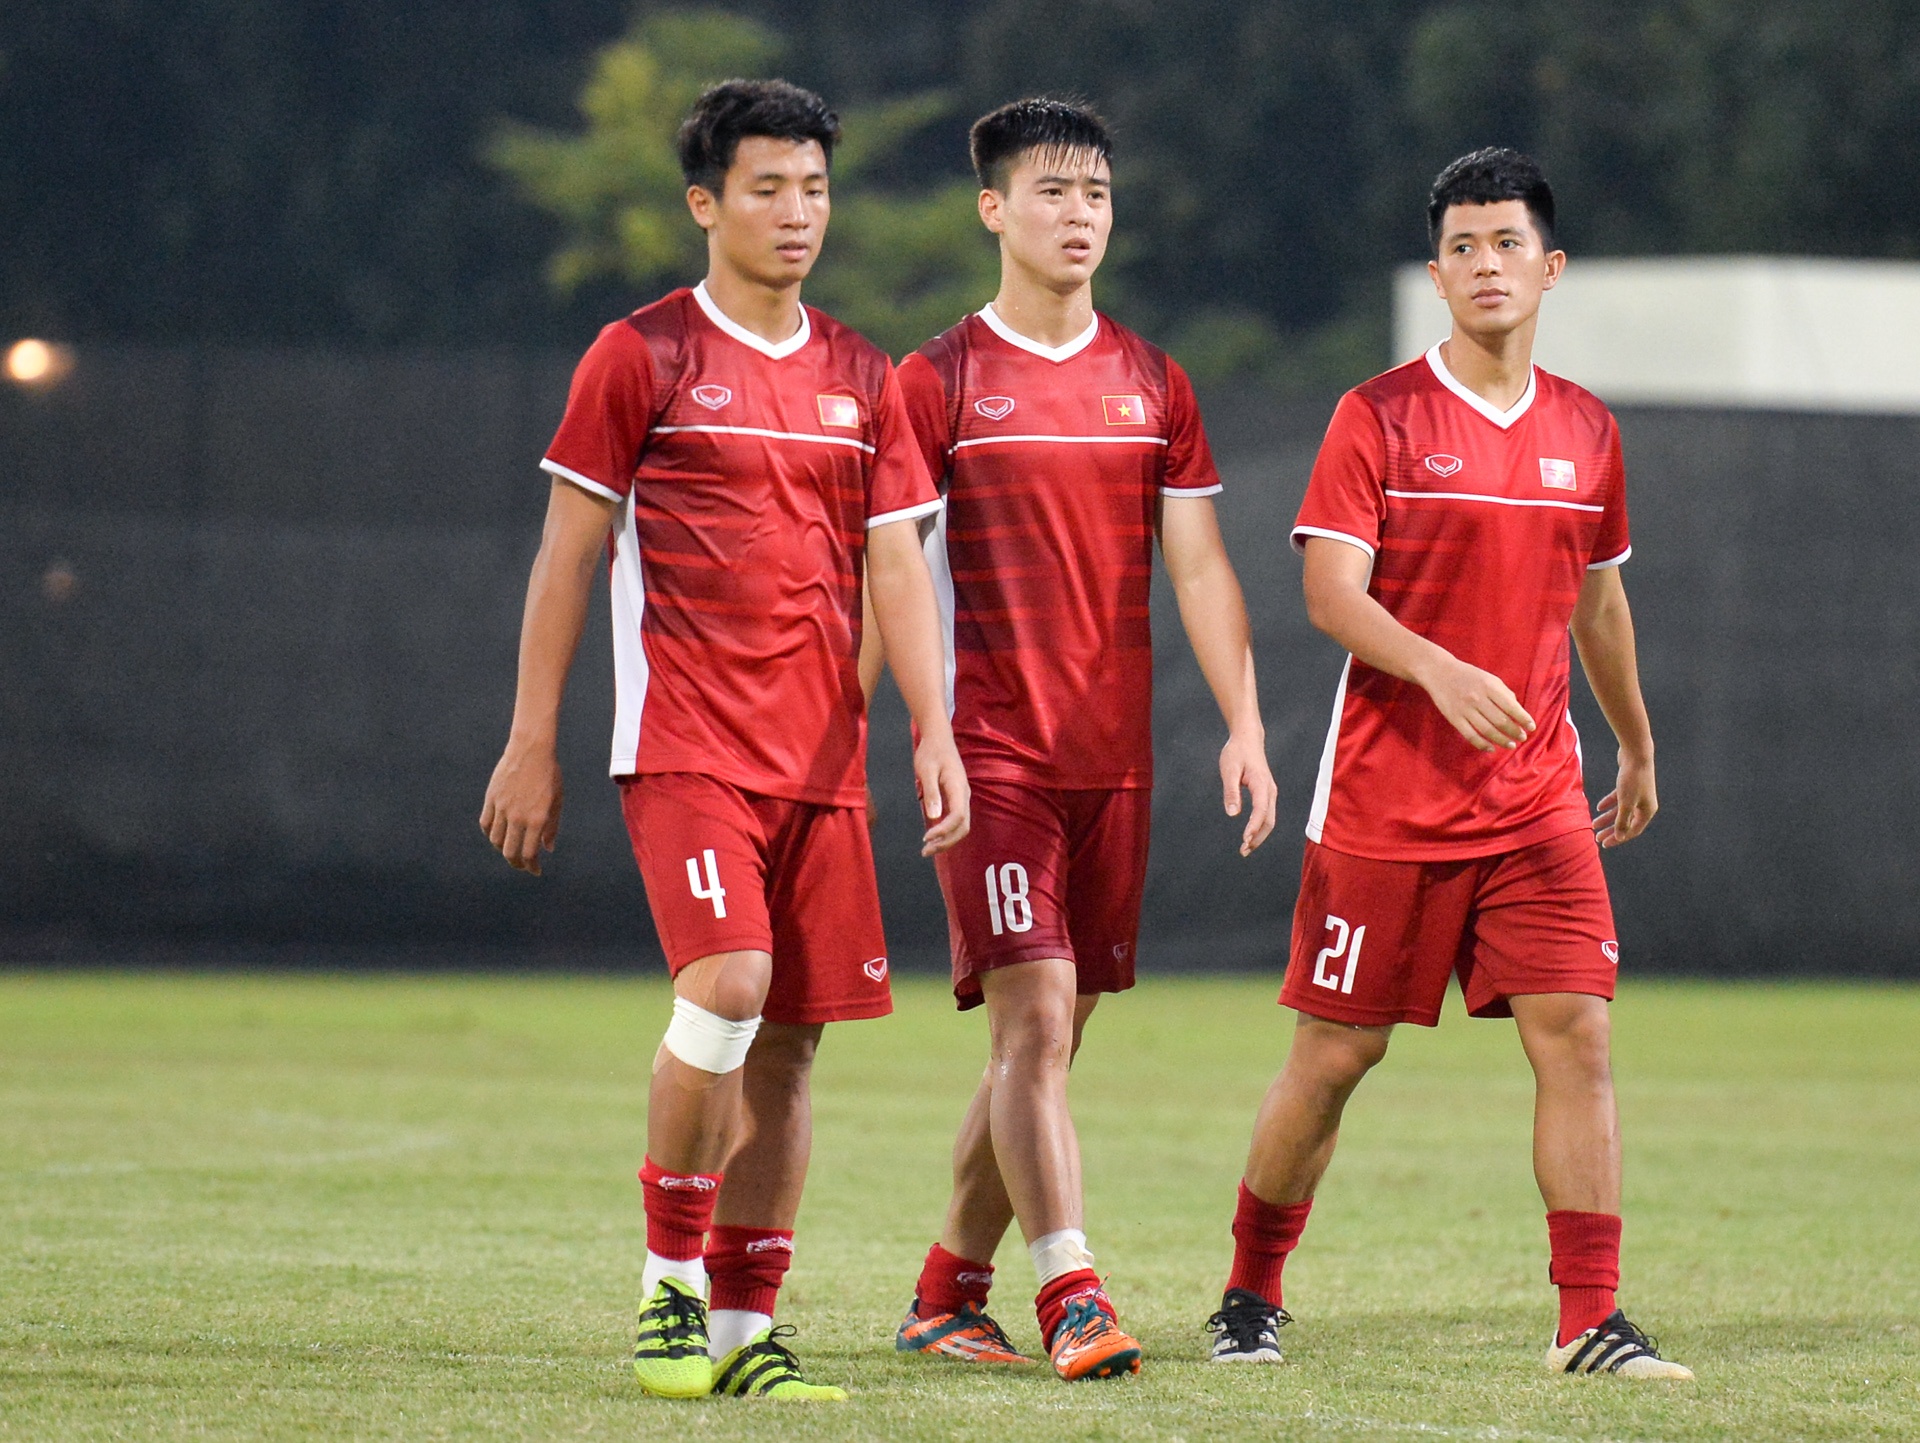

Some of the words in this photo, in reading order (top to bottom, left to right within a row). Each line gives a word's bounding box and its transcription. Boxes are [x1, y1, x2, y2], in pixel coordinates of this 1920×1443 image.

[686, 849, 726, 918] 4
[985, 862, 1033, 935] 18
[1312, 914, 1366, 994] 21
